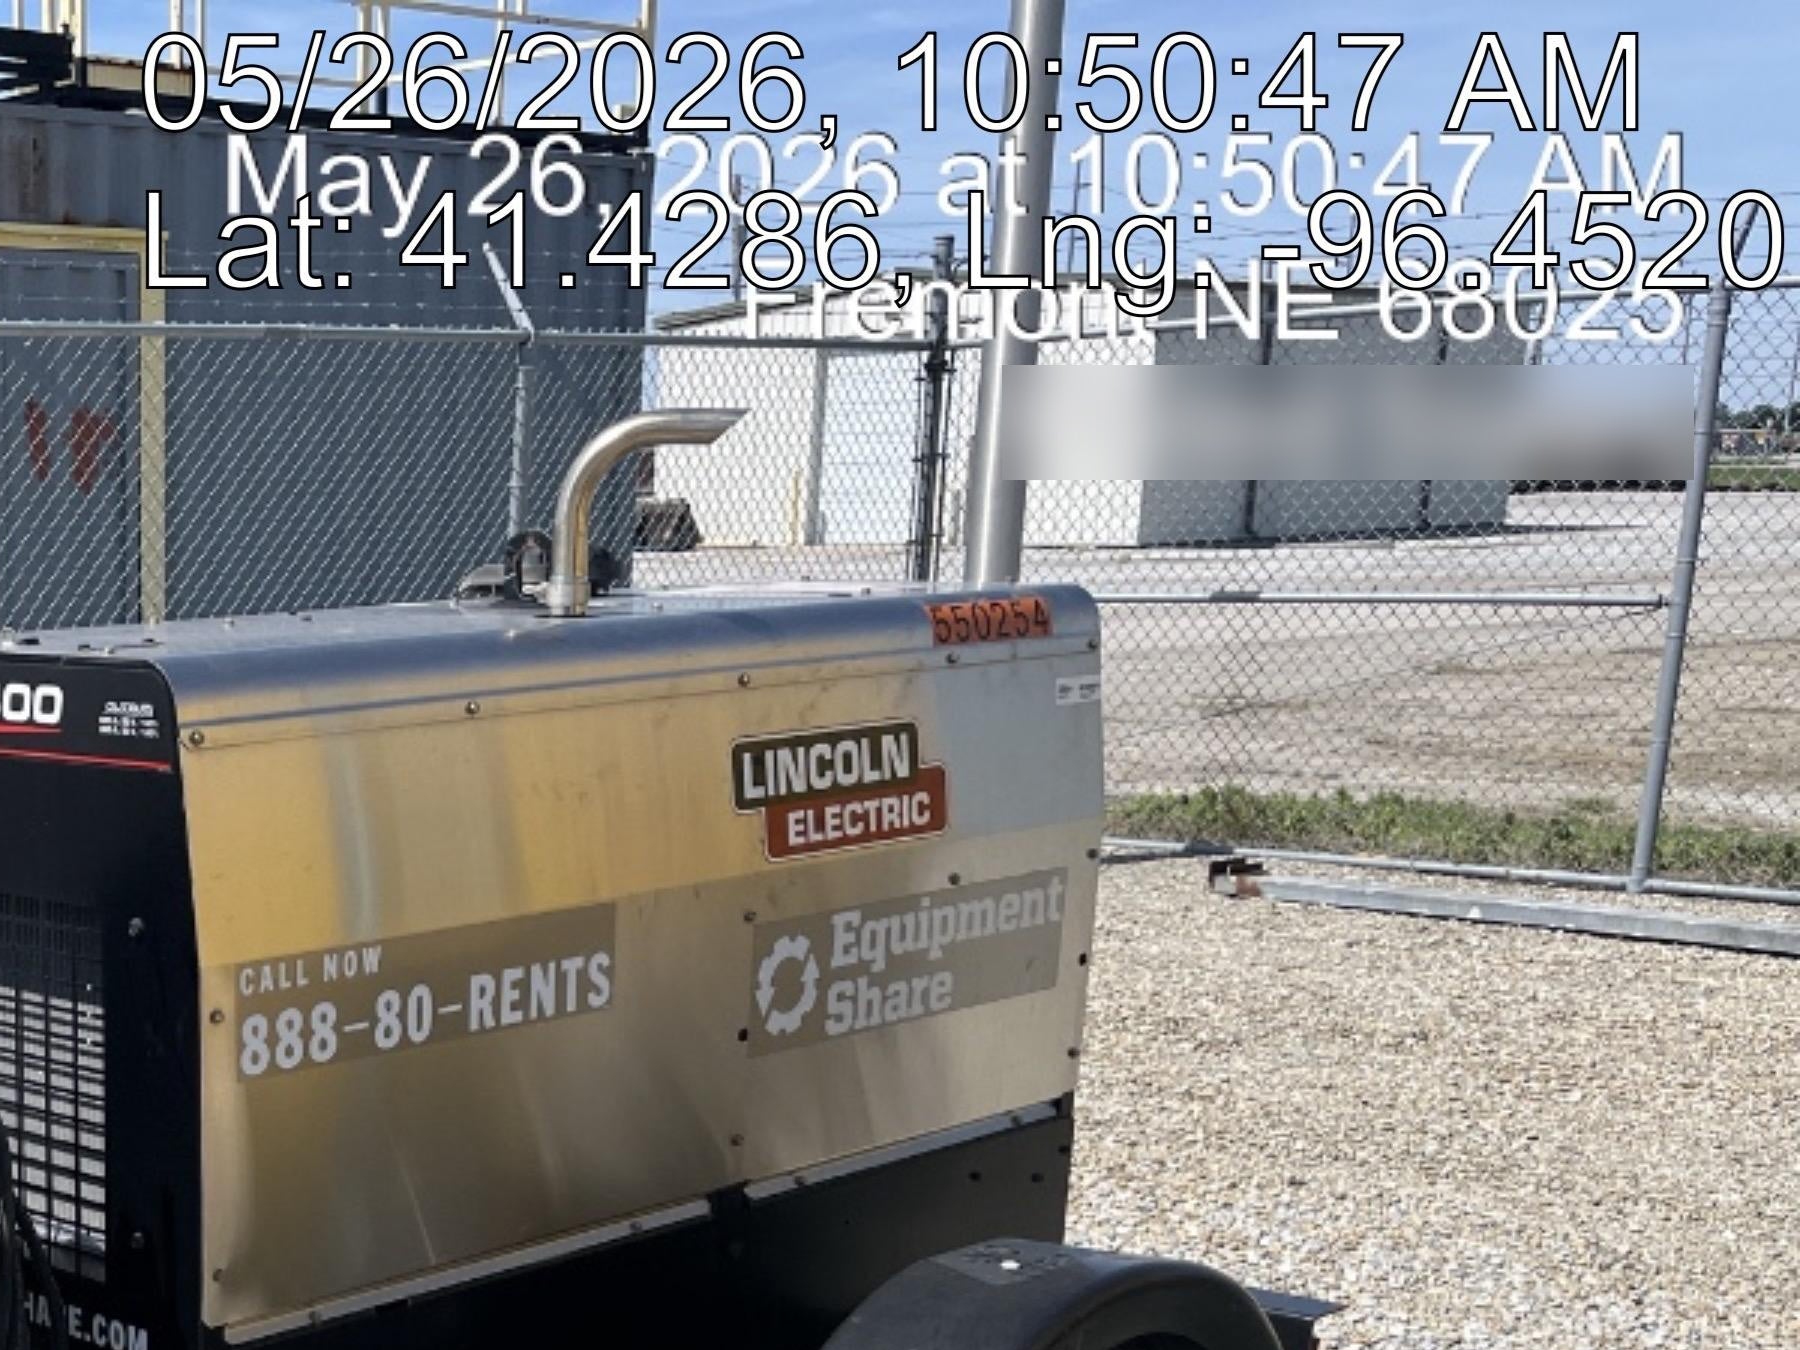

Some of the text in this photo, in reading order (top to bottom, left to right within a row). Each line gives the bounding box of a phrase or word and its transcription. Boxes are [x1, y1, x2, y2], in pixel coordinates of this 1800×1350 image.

[931, 598, 1051, 644] 550254
[742, 731, 911, 800] LINCOLN
[786, 791, 932, 847] ELECTRIC
[830, 880, 1064, 972] Equipment
[238, 945, 384, 997] CALL NOW
[823, 966, 954, 1037] Share
[239, 952, 613, 1077] 888-80-RENTS
